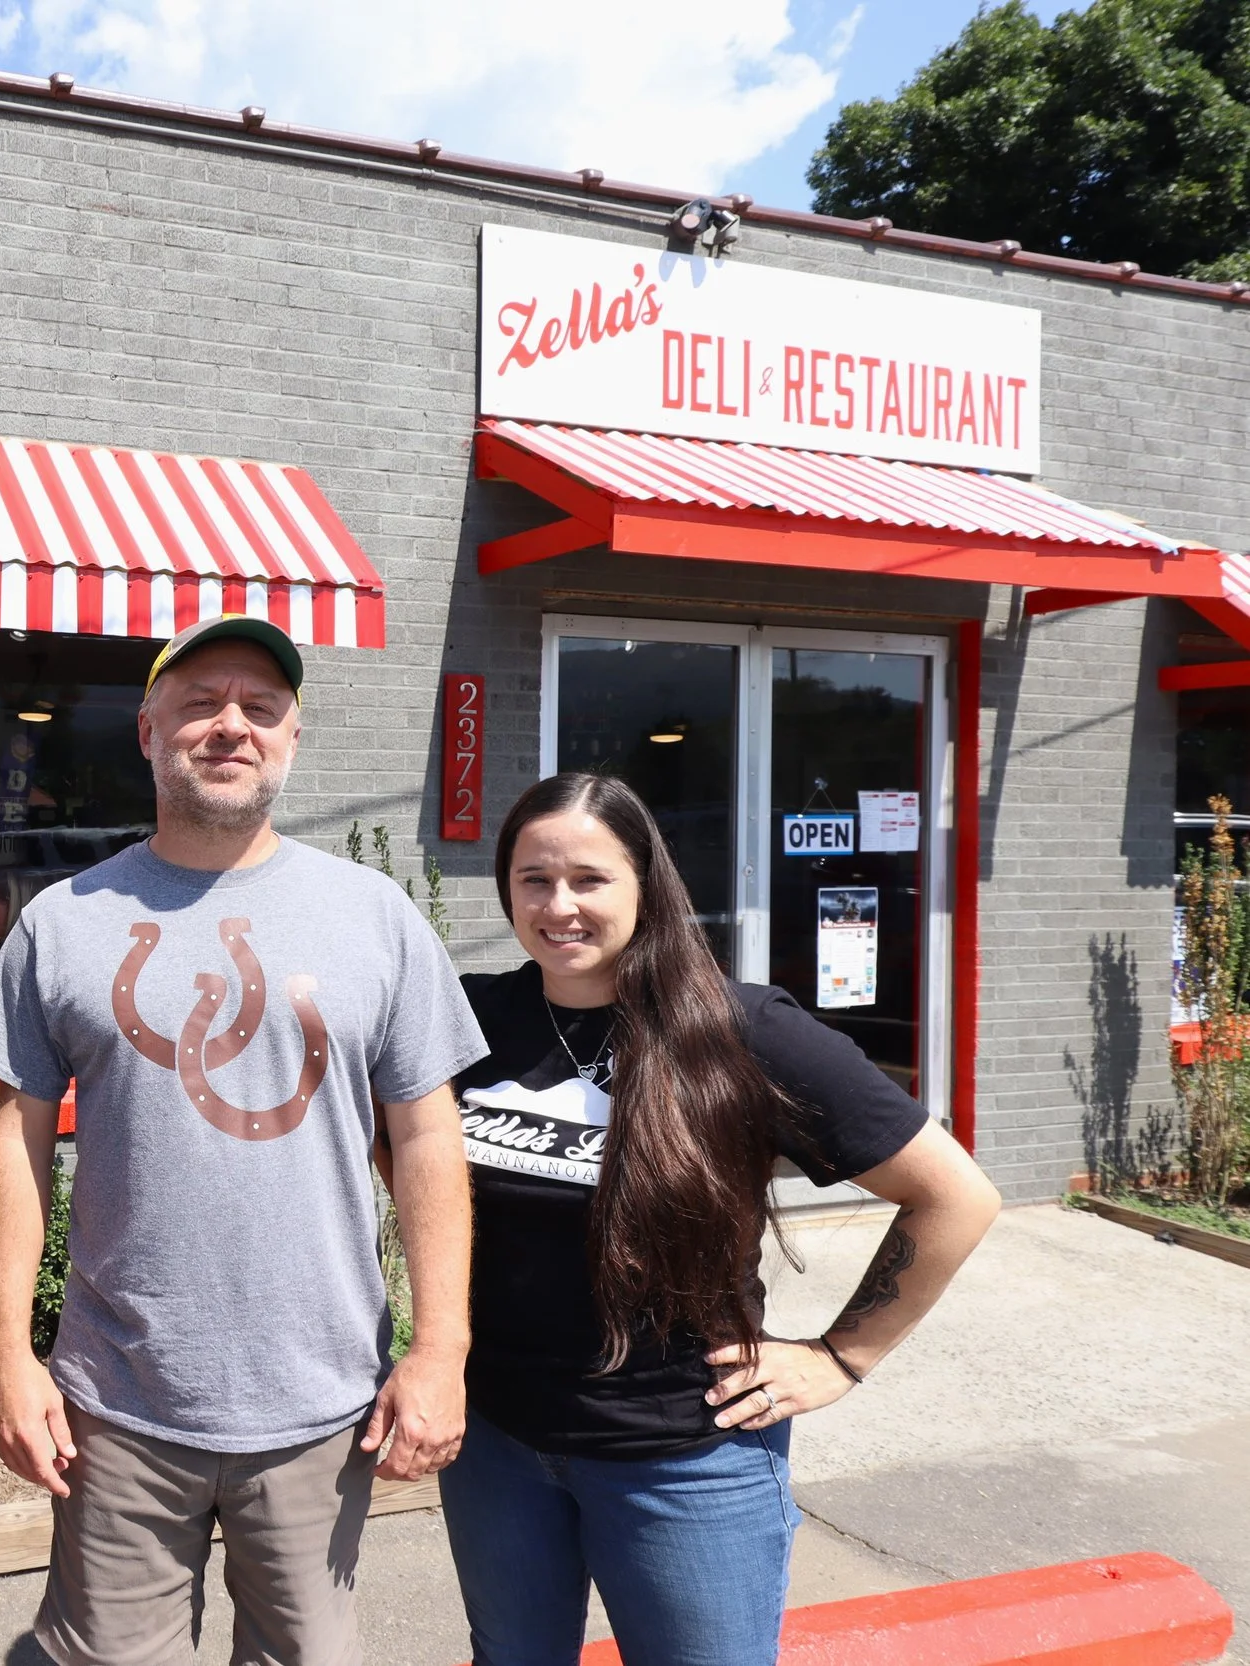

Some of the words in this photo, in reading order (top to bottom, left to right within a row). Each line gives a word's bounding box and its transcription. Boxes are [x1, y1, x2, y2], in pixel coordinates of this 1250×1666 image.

[497, 262, 663, 377] Zella's
[661, 329, 751, 417] DELI
[758, 366, 773, 397] &
[782, 345, 1028, 450] RESTAURANT
[454, 682, 478, 822] 2372
[789, 822, 849, 848] OPEN
[467, 1144, 596, 1182] WANNANOA
